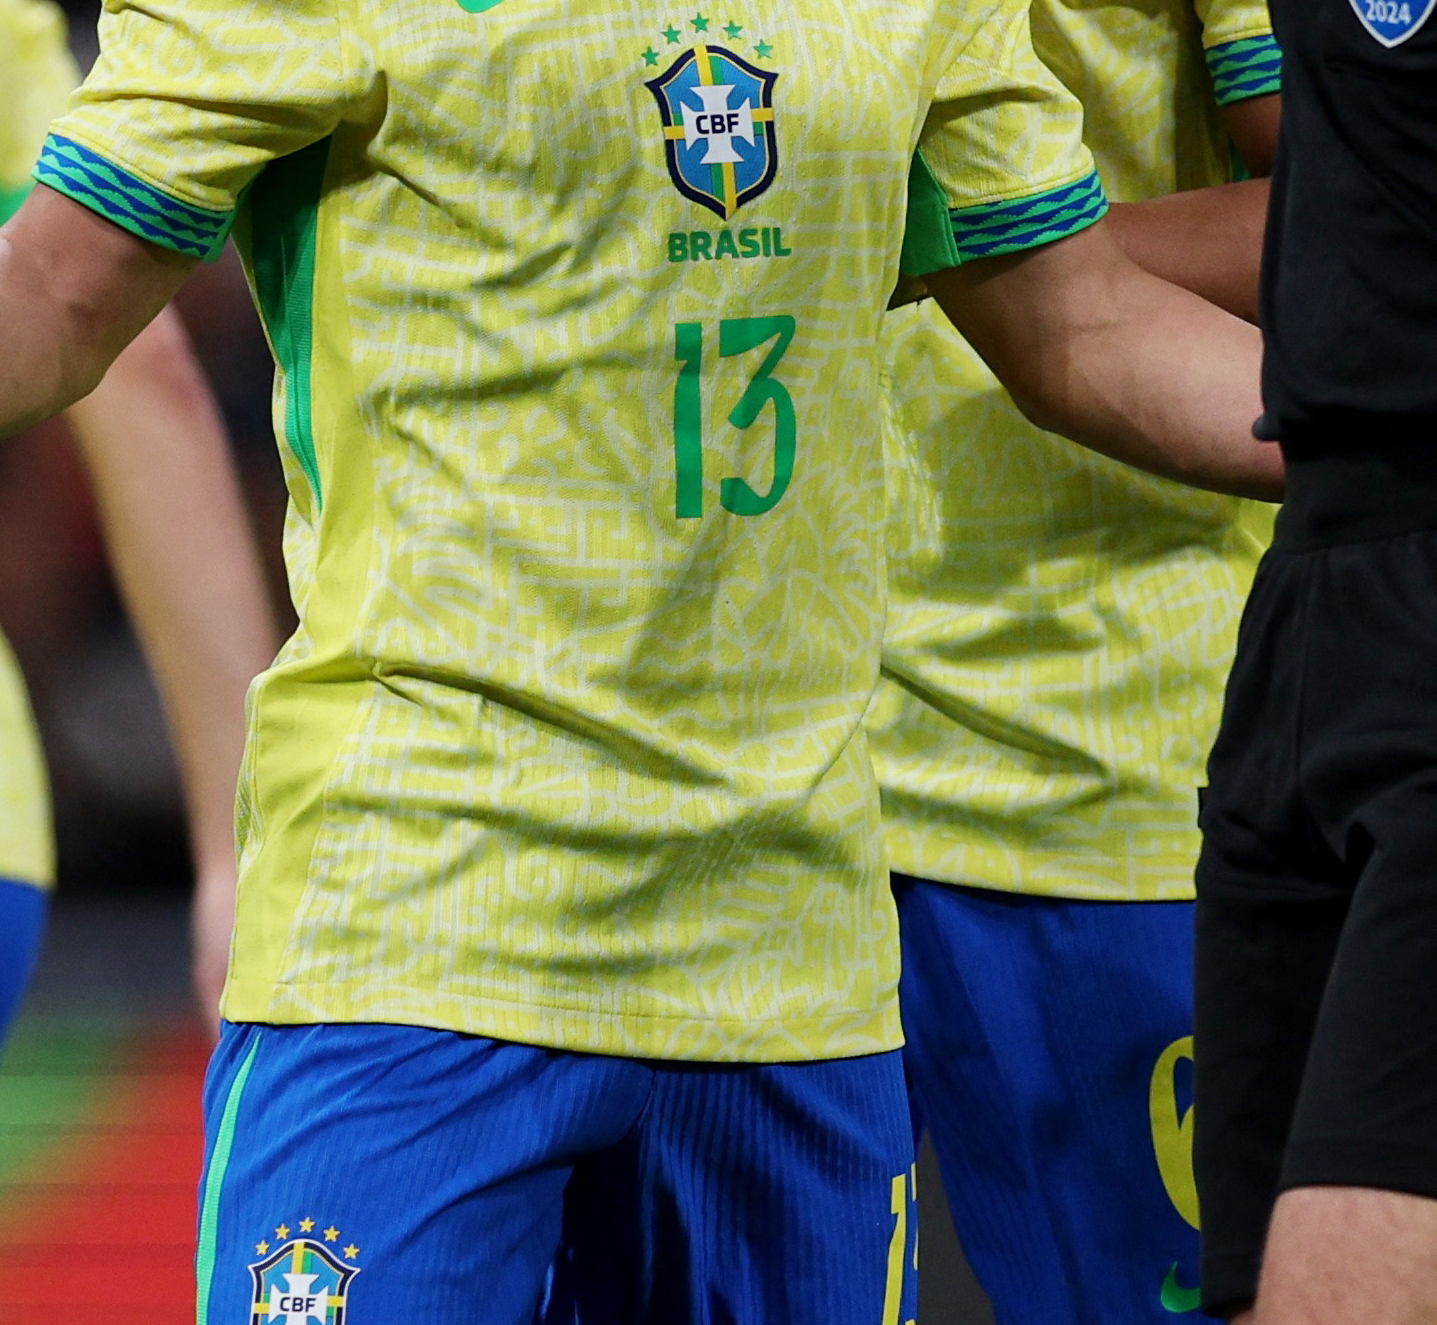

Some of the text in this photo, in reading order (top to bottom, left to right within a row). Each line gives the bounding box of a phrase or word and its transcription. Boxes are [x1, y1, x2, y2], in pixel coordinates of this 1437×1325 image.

[695, 113, 740, 135] CBF
[668, 227, 792, 263] BRASIL
[673, 315, 796, 519] 13
[279, 1296, 317, 1312] CBF
